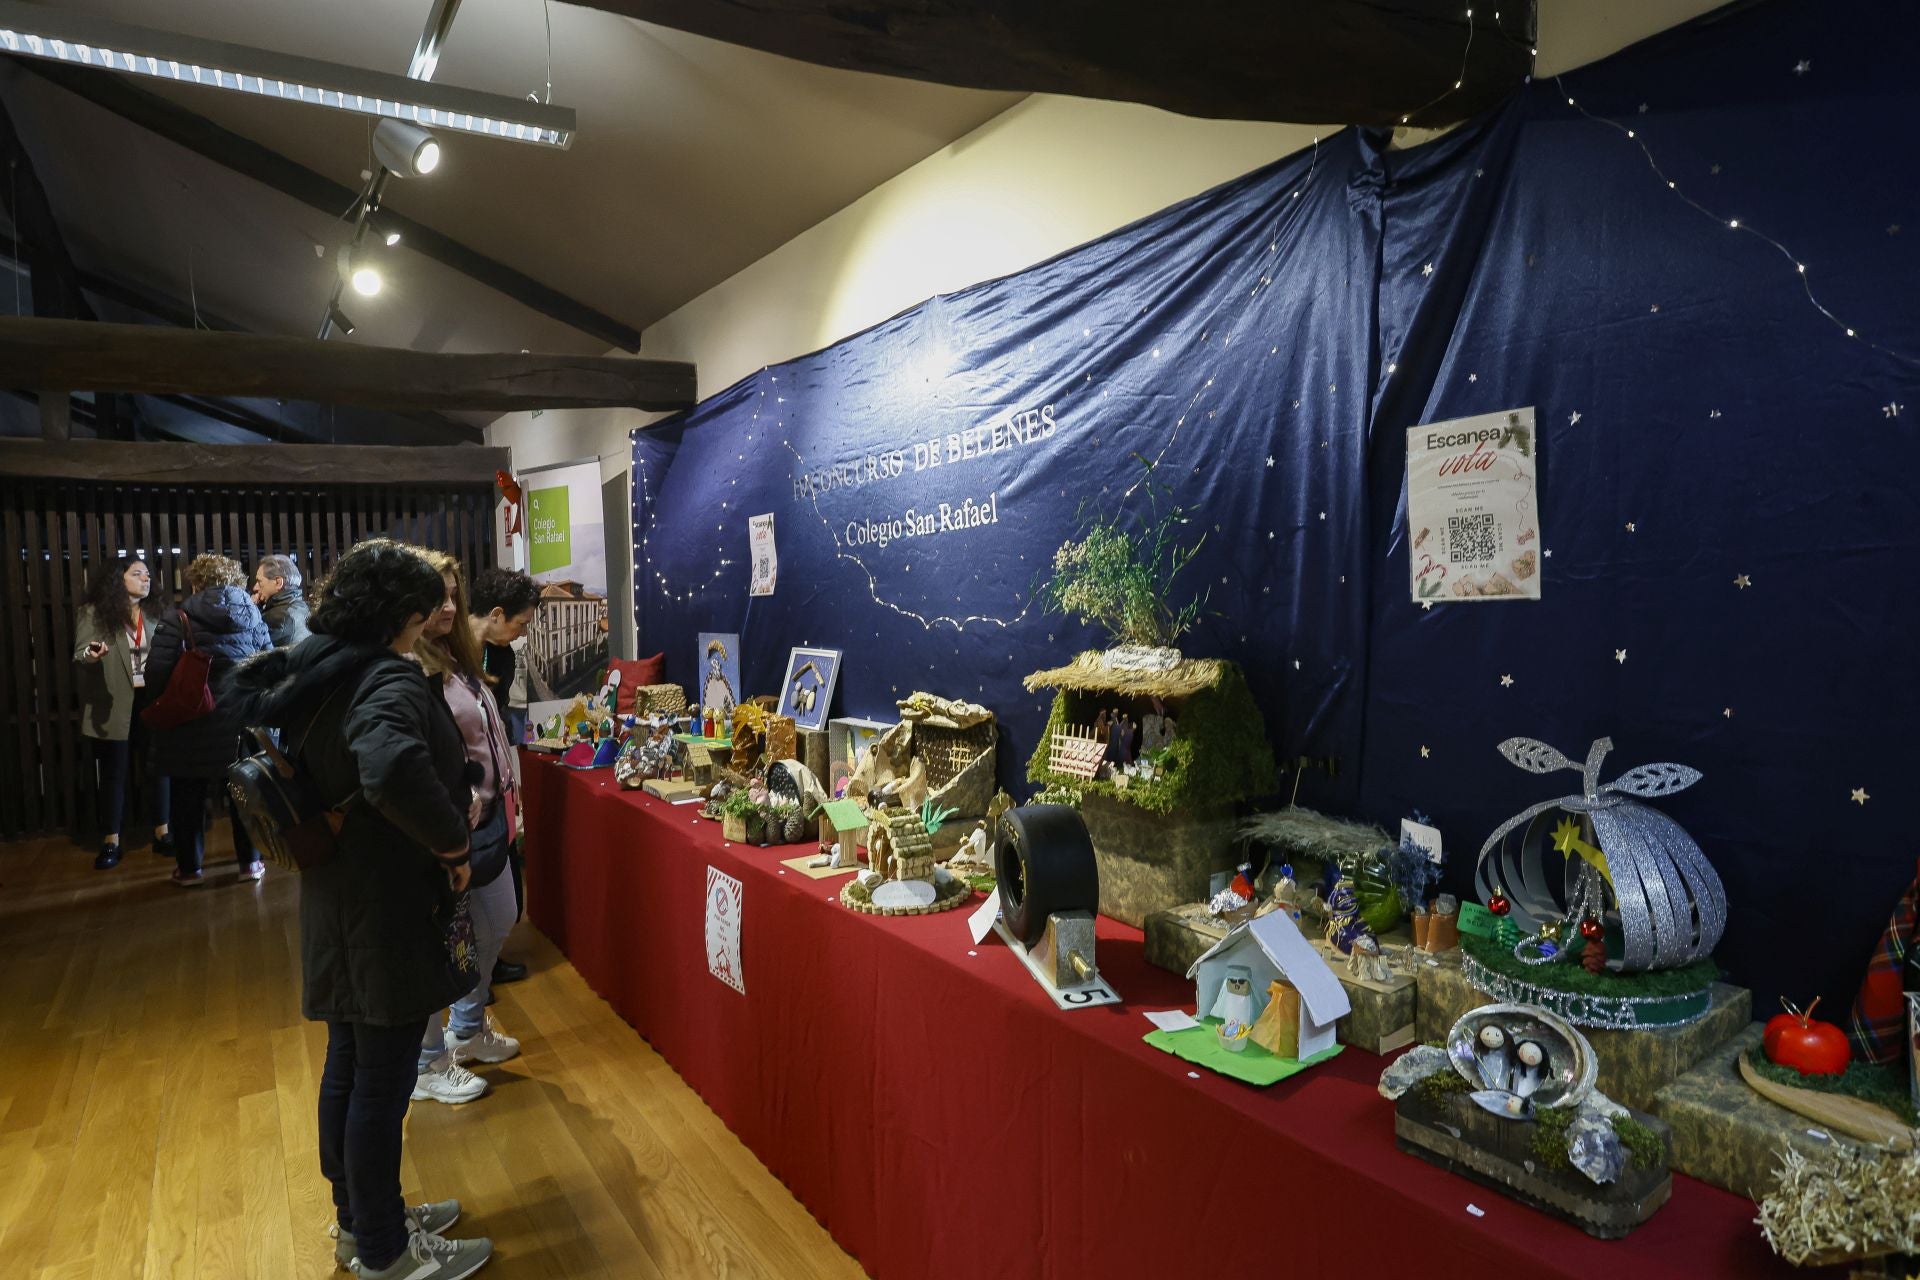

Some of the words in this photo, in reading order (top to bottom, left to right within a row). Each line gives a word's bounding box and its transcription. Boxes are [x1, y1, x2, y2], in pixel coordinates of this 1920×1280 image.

[811, 450, 903, 494] CONCURSO
[914, 438, 942, 471] DE
[947, 404, 1056, 463] BELENES
[1427, 428, 1501, 450] Escanea
[1439, 440, 1497, 477] vota
[533, 516, 556, 532] Colegio
[846, 515, 902, 547] Colegio
[905, 509, 936, 537] San
[938, 492, 998, 532] Rafael
[534, 533, 545, 545] San
[546, 529, 565, 543] Rafael
